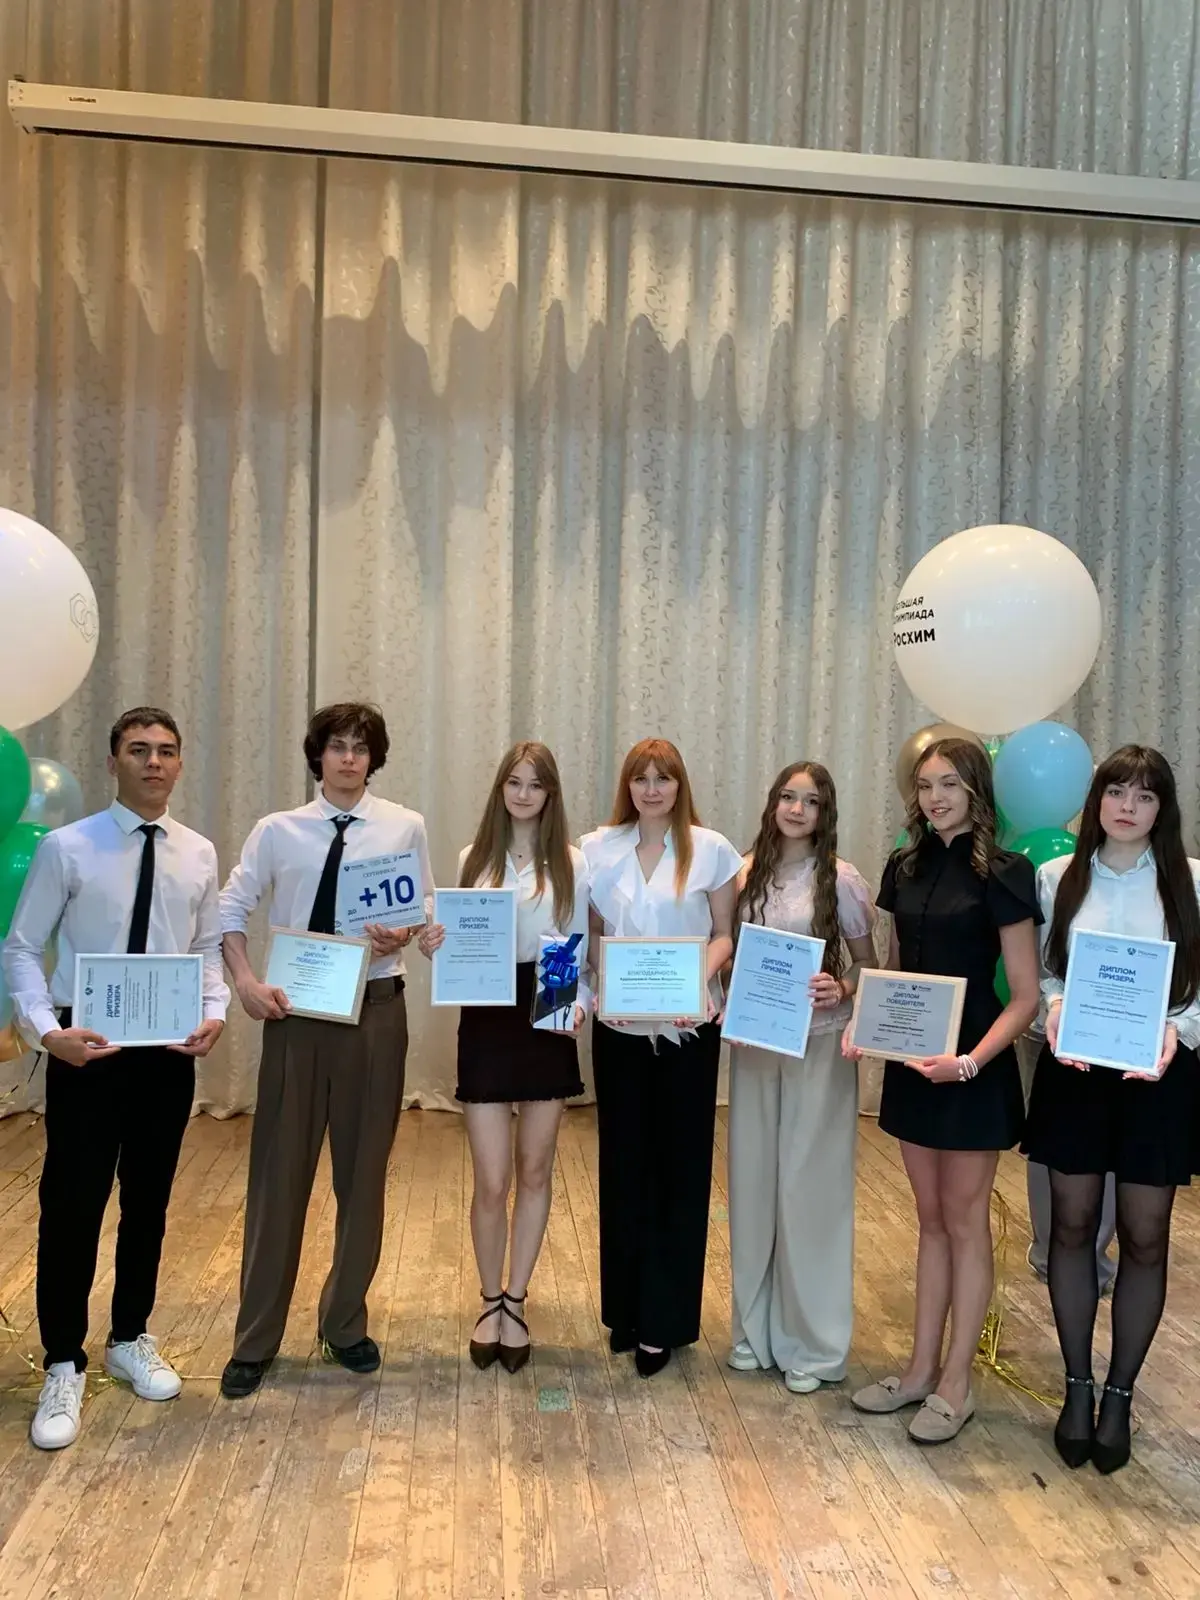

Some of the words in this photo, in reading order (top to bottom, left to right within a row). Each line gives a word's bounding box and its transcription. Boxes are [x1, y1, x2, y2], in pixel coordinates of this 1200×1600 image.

[359, 874, 415, 907] +10
[459, 916, 489, 924] ДИПЛОМ
[762, 956, 793, 969] ДИПЛОМ
[760, 963, 791, 976] ПРИЗЕРА
[1099, 964, 1137, 977] ДИПЛОМ
[1098, 972, 1136, 984] ПРИЗЕРА
[106, 984, 114, 1018] ДИПЛОМ
